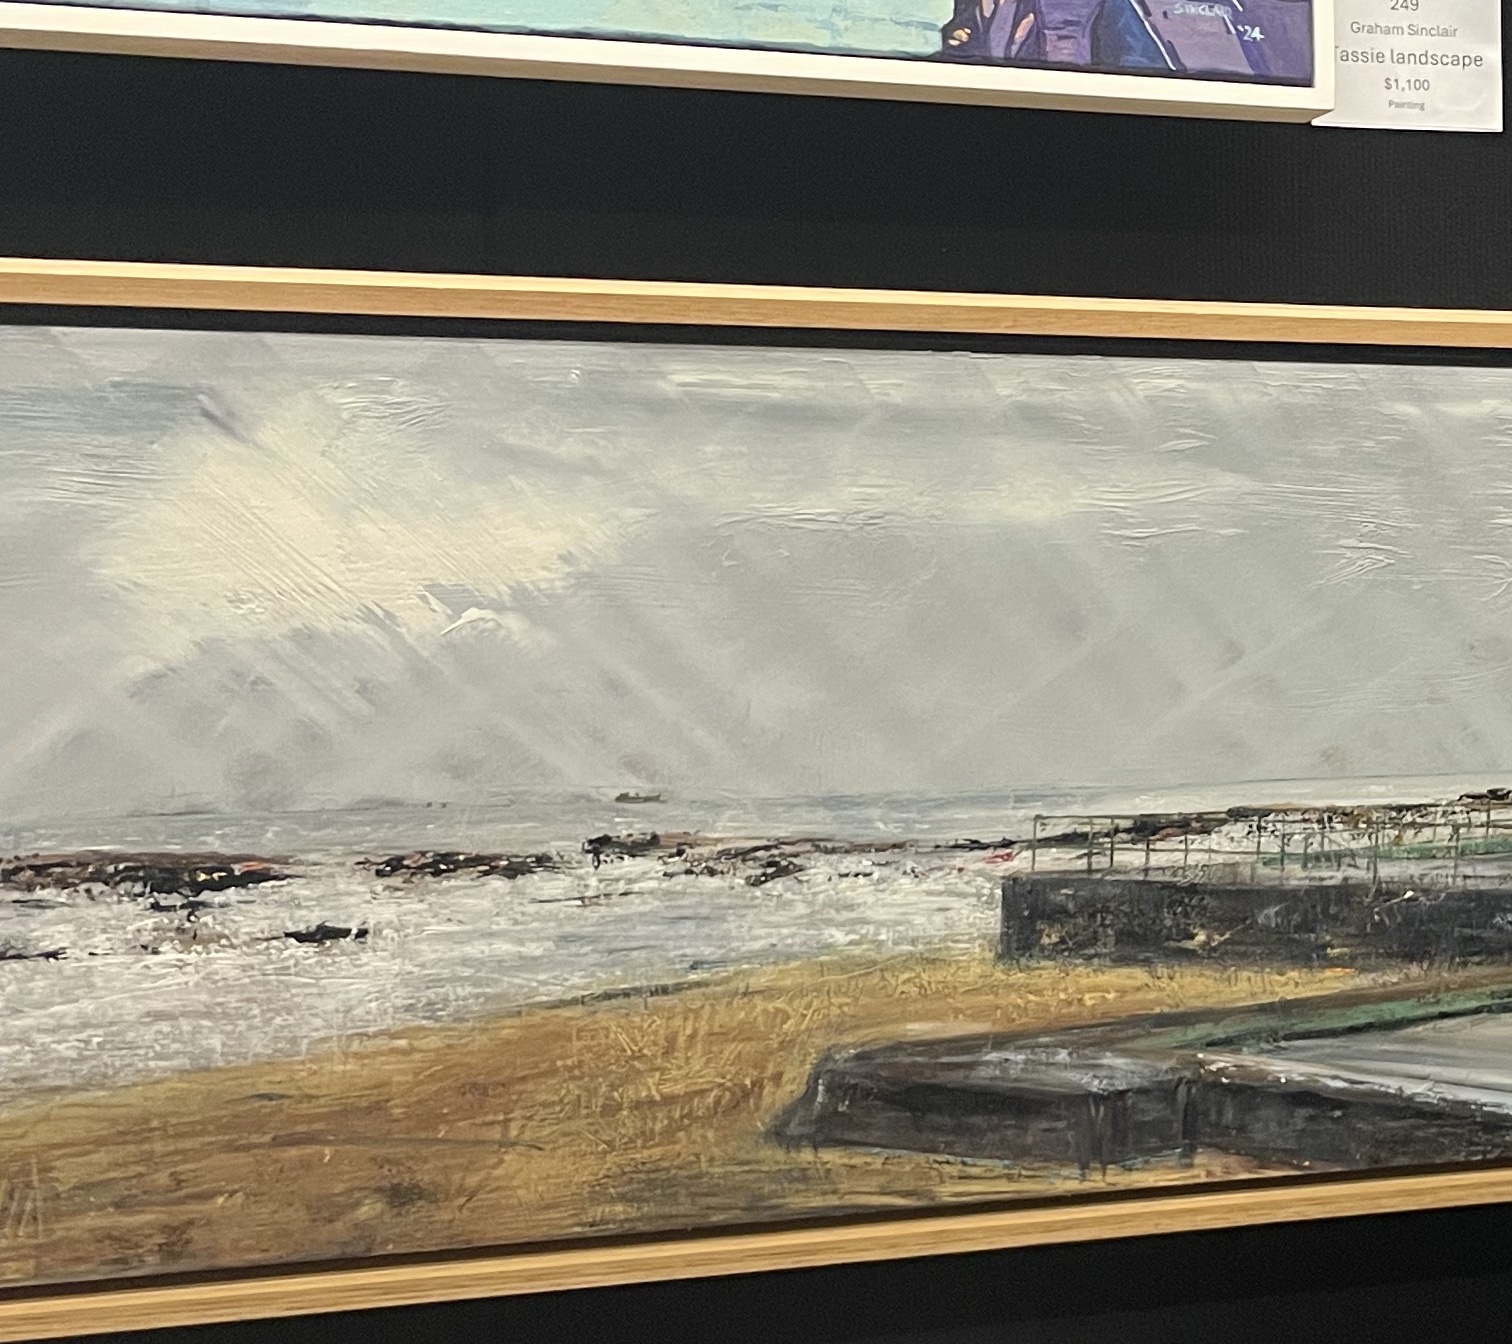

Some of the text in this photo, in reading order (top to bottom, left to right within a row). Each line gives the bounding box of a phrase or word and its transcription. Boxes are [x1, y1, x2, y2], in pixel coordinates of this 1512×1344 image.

[1350, 21, 1458, 38] Graham Sinclair
[1390, 49, 1484, 70] landscape
[1384, 77, 1430, 92] $1,100
